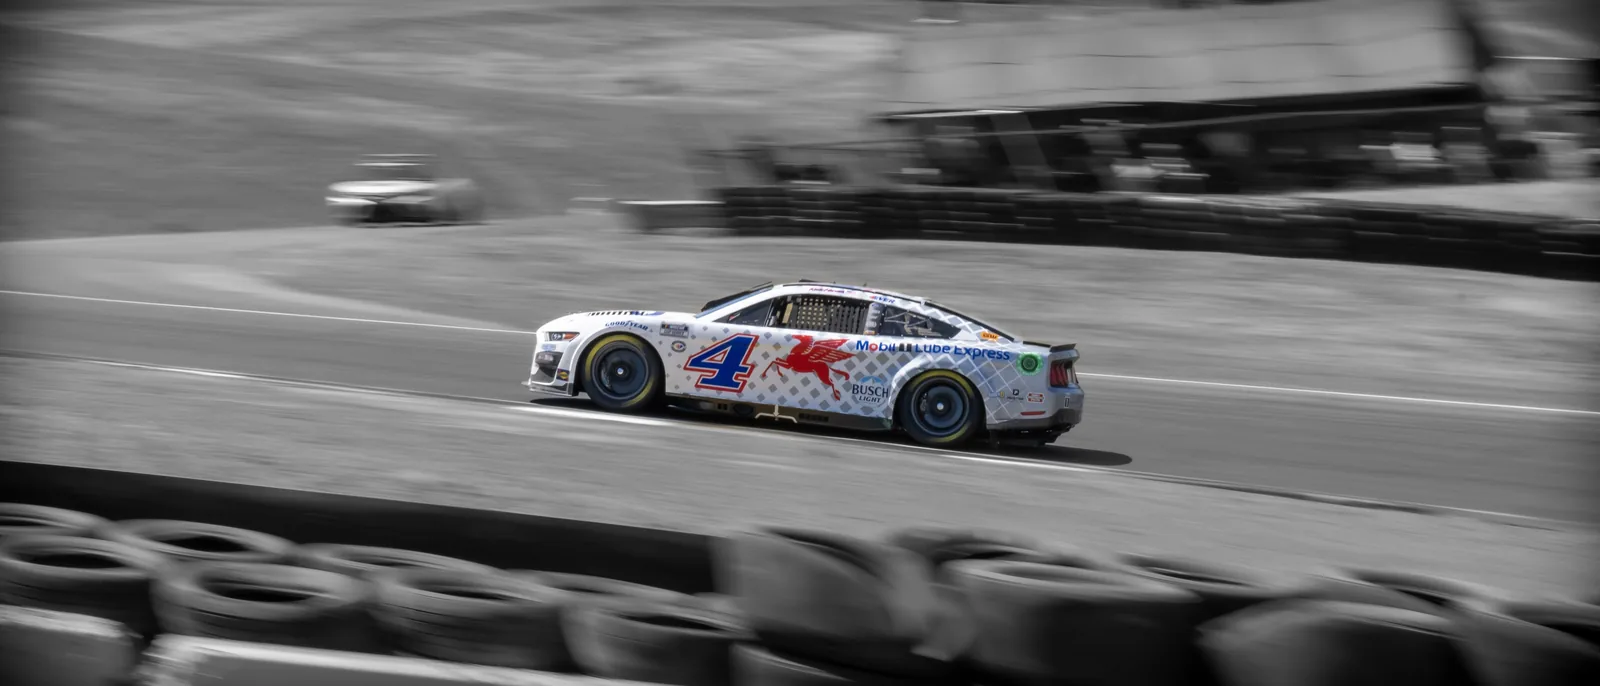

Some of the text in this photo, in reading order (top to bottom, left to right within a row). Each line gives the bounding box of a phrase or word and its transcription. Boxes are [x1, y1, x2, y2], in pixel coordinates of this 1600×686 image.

[855, 340, 1010, 360] Mobil Lube Express
[683, 333, 760, 393] 4
[851, 383, 889, 398] BUSCH
[858, 395, 881, 403] LIGHT
